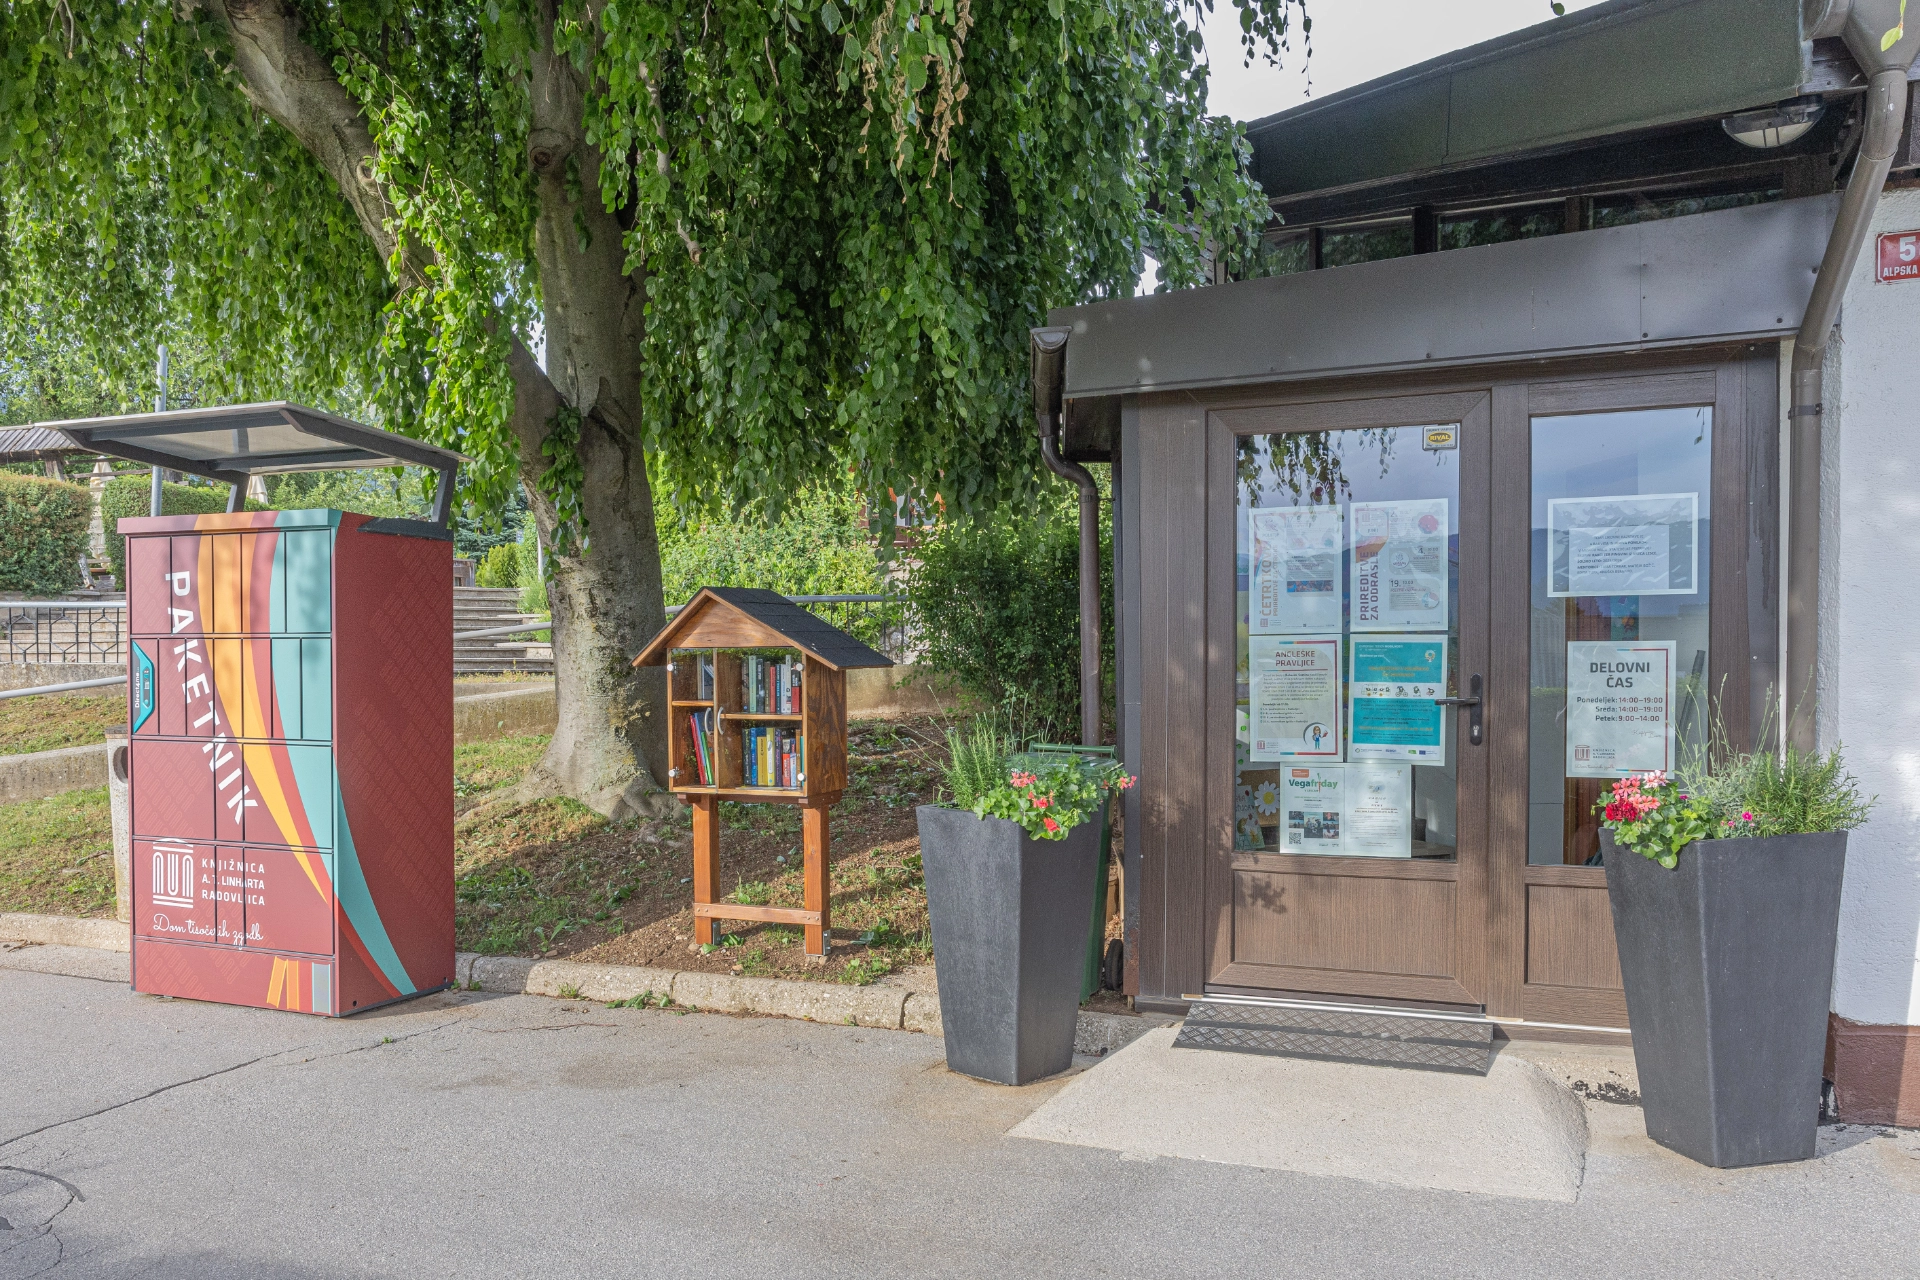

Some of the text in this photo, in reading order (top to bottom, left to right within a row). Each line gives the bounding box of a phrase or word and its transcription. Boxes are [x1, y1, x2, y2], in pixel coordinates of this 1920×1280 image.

[1883, 265, 1918, 277] ALPSKA
[1360, 551, 1369, 621] PRIREDITVE
[1370, 551, 1379, 621] ZA ODRASLE
[1276, 659, 1315, 667] PRAVLJICE
[1590, 662, 1650, 673] DELOVNI
[1606, 674, 1633, 688] ČAS
[165, 571, 258, 825] PAKETNIK
[1577, 696, 1618, 705] Ponedeljek:
[1288, 779, 1338, 789] Vegafriday
[201, 858, 265, 874] KNJIŽNICA
[202, 874, 210, 884] A.
[221, 876, 265, 890] LINHARTA
[201, 889, 265, 906] RADOVLICA
[153, 913, 186, 931] Dom
